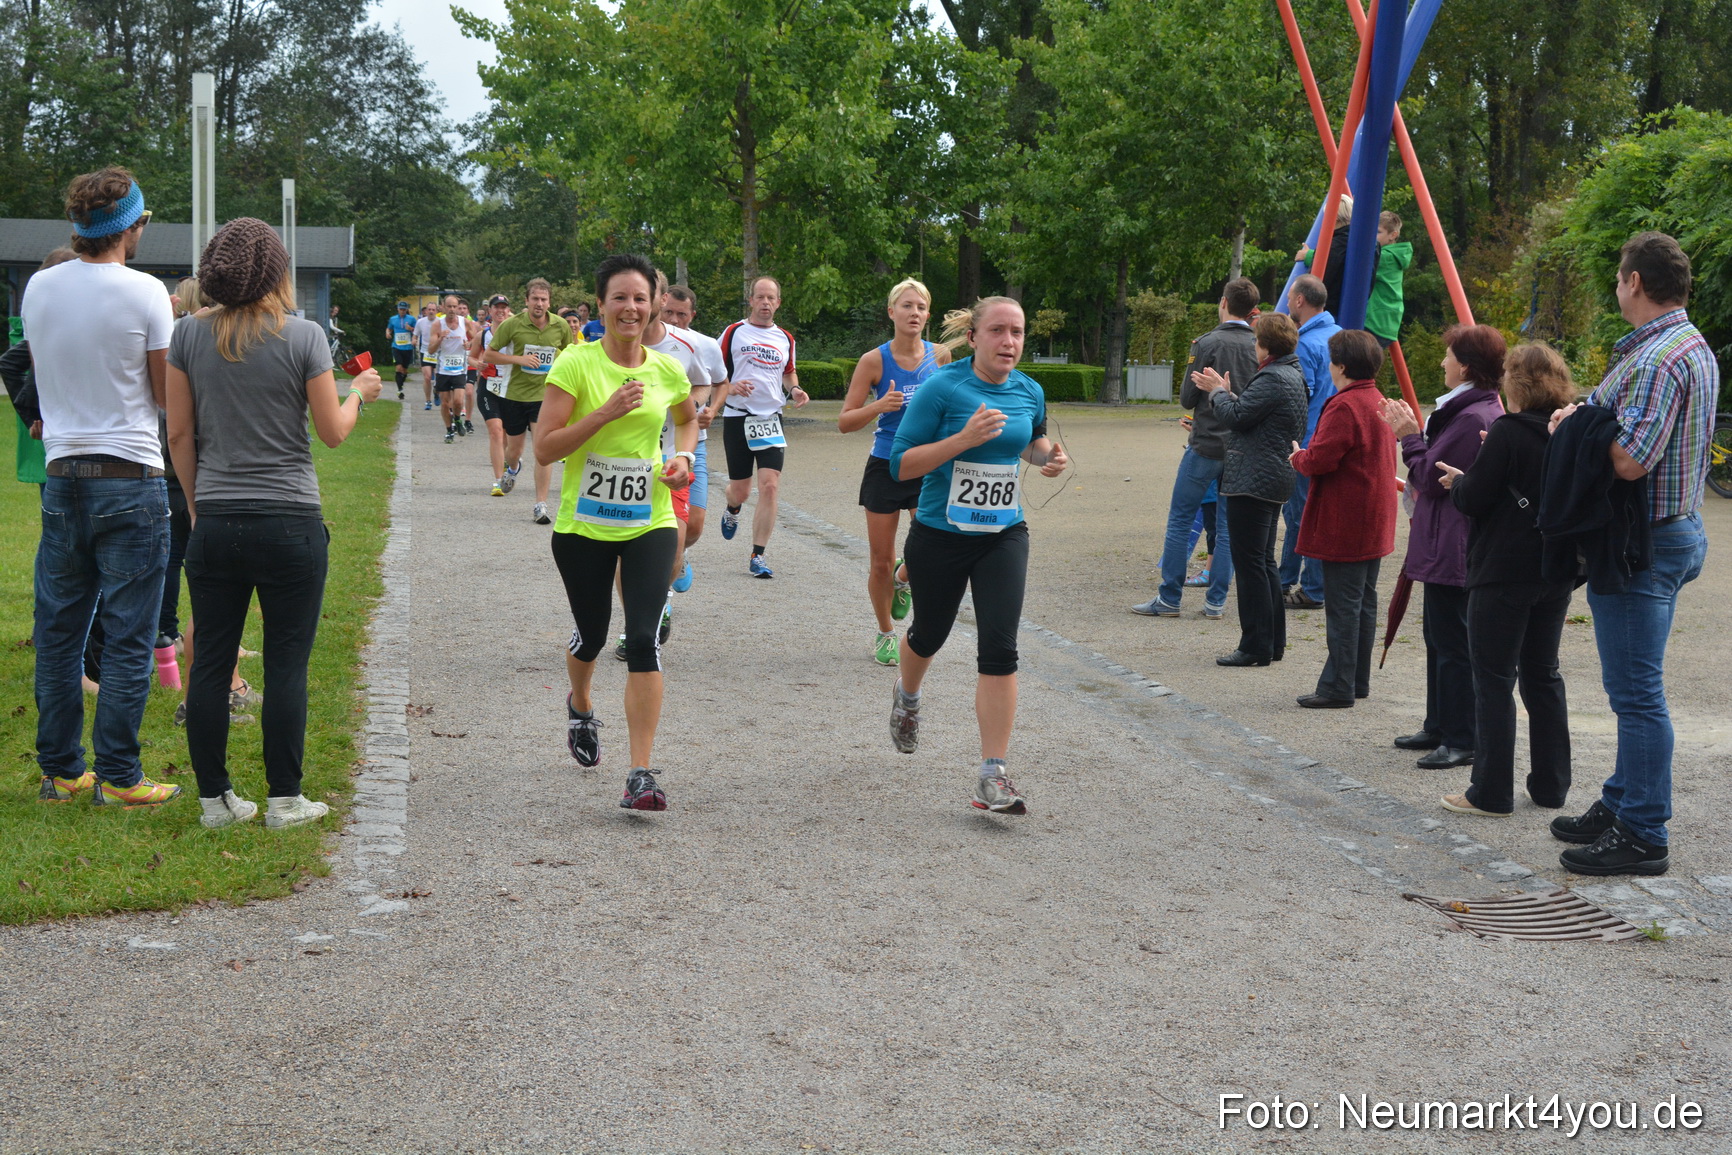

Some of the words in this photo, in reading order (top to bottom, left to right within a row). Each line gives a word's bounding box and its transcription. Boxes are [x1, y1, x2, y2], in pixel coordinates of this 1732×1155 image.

[748, 423, 779, 438] 3354
[586, 458, 610, 471] PARTL
[611, 464, 644, 472] Neumarkt
[955, 467, 980, 478] PARTL
[982, 471, 1014, 479] Neumarkt
[587, 471, 647, 501] 2163
[957, 478, 1016, 507] 2368
[596, 505, 633, 518] Andrea
[970, 511, 998, 523] Maria
